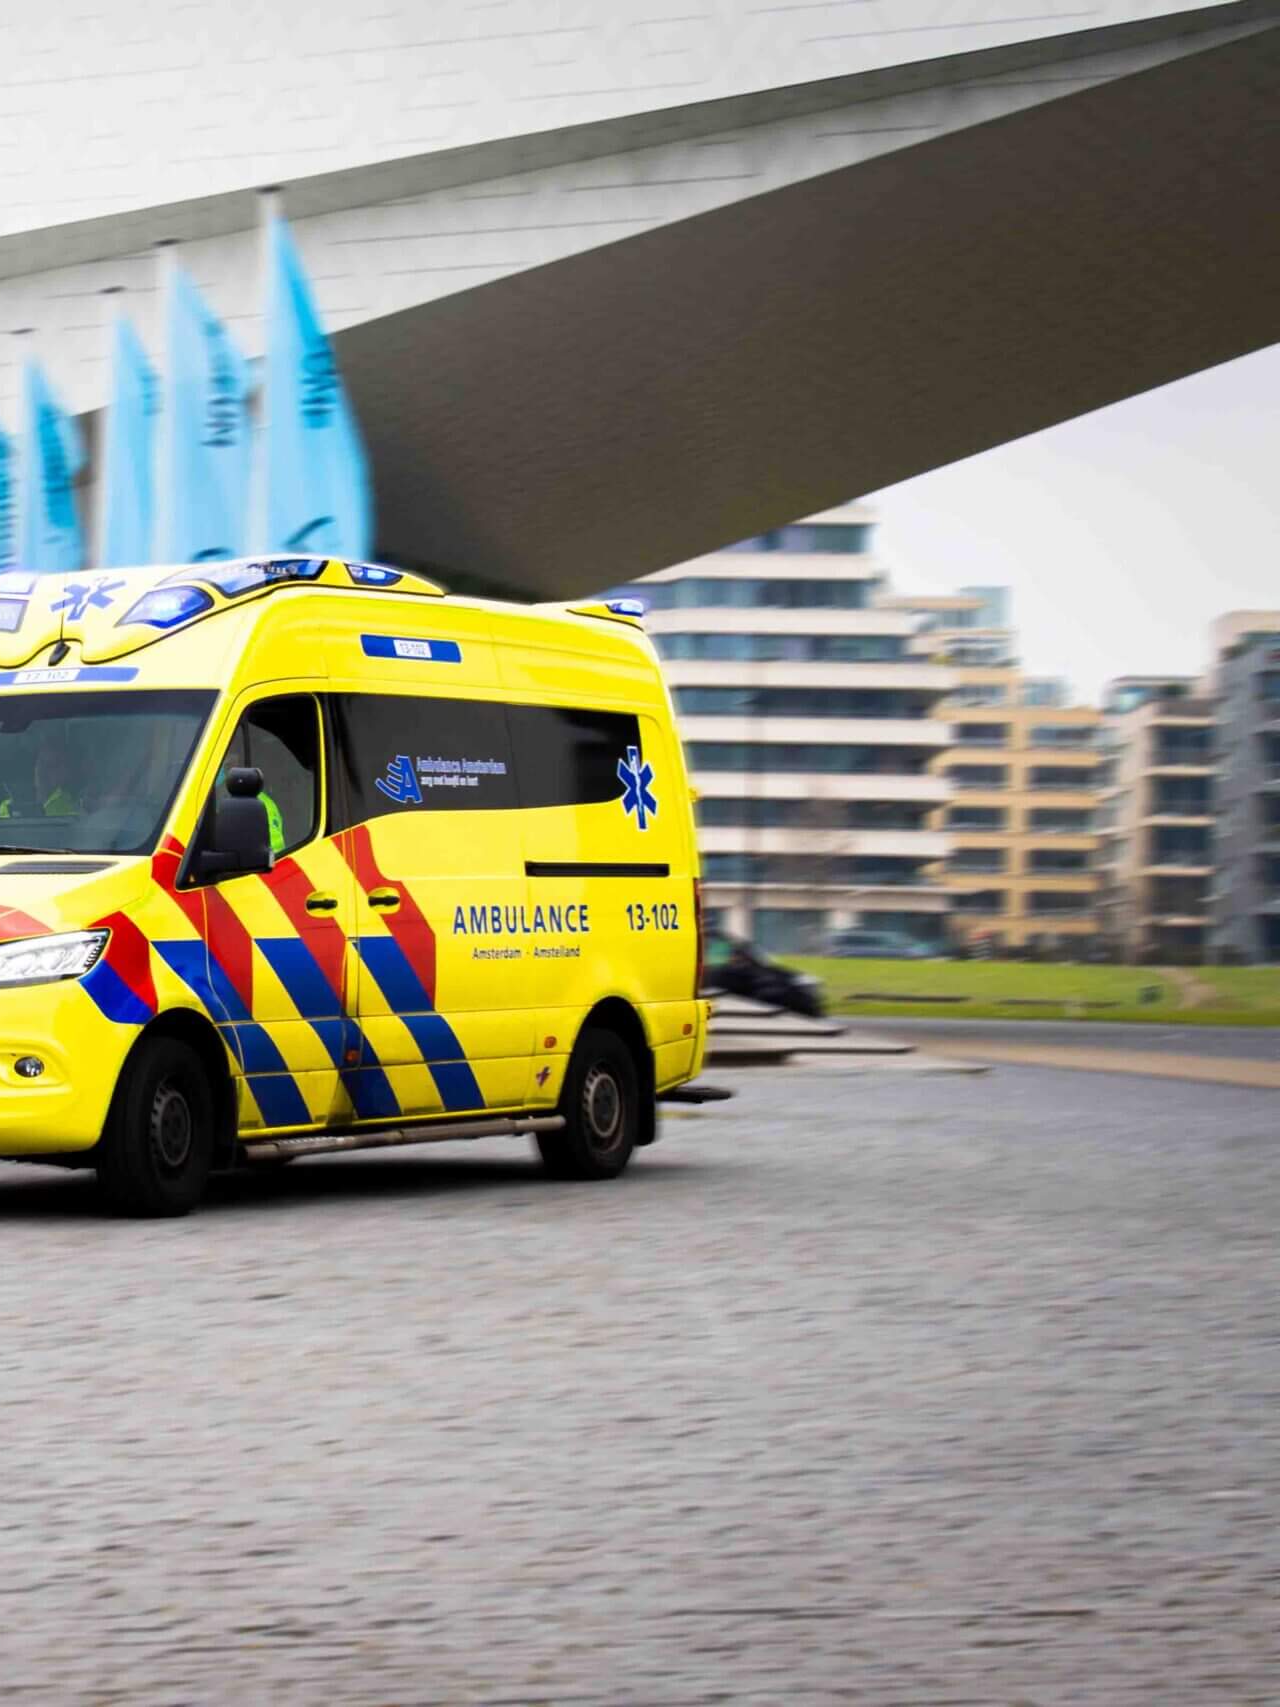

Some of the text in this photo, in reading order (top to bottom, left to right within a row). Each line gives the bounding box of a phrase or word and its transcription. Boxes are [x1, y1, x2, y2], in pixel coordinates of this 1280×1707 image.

[453, 905, 589, 934] AMBULANCE
[472, 946, 521, 959] Amsterdam
[533, 945, 580, 958] Amstelland
